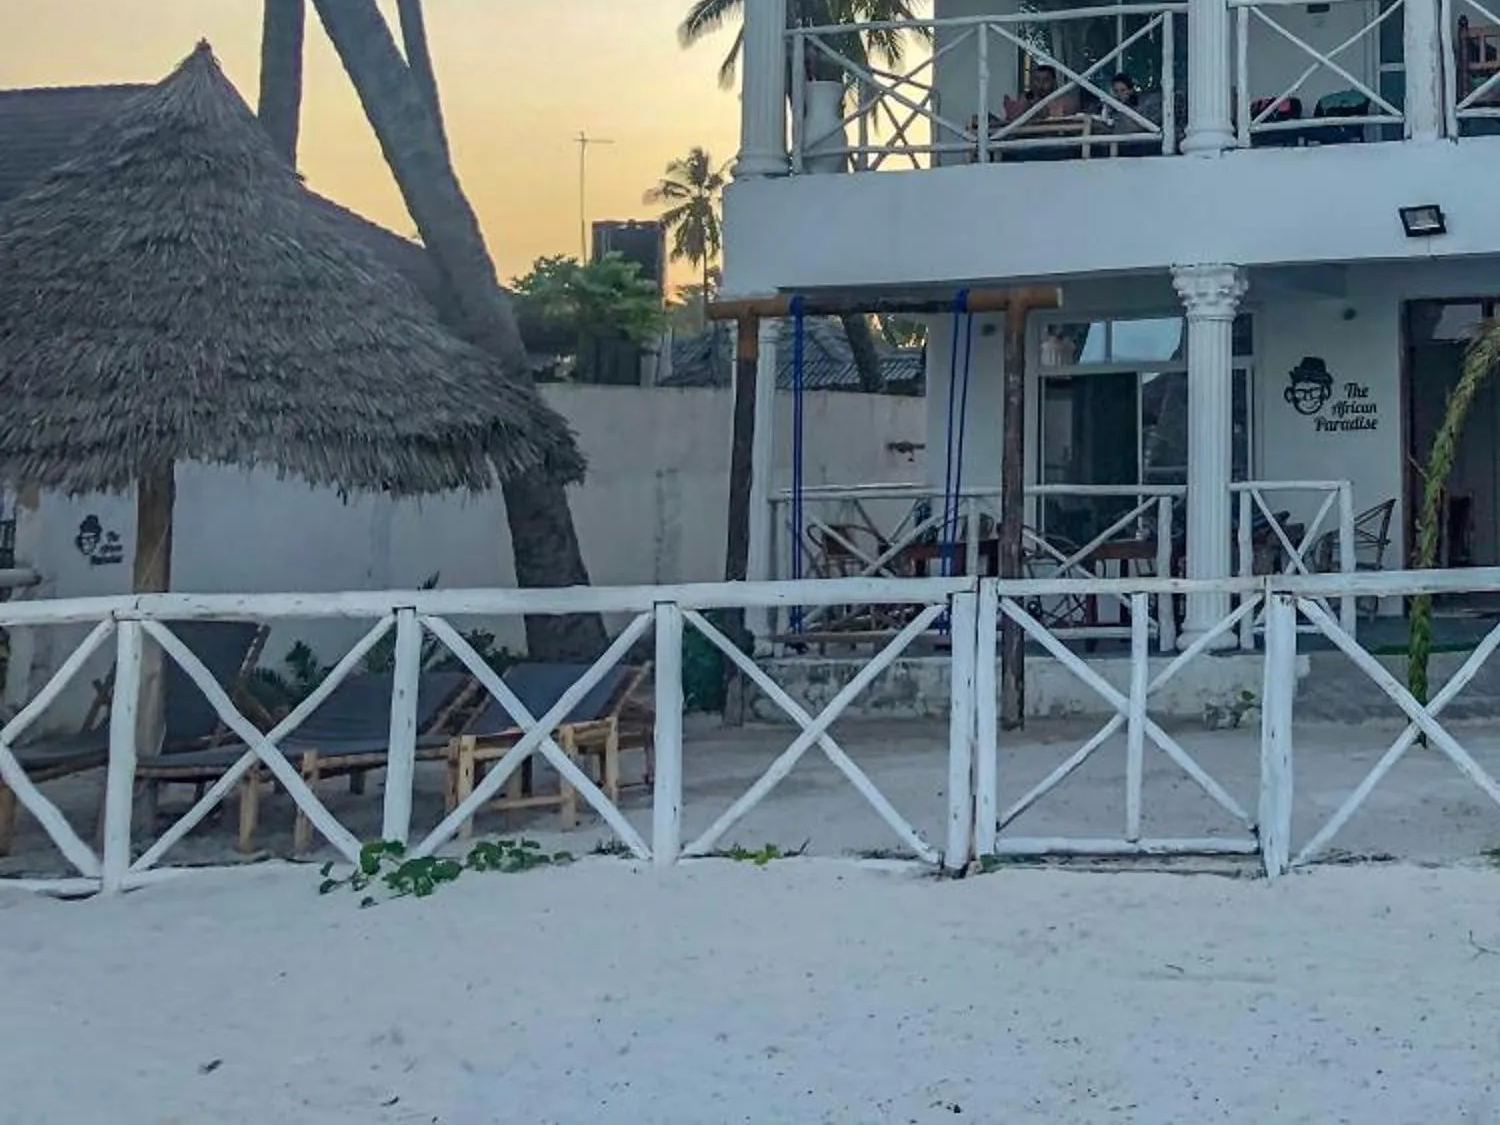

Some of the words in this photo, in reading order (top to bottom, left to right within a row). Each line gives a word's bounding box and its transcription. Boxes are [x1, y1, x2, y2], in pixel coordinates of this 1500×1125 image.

[1344, 382, 1369, 398] The
[1332, 400, 1377, 418] African
[1314, 416, 1378, 432] Paradise
